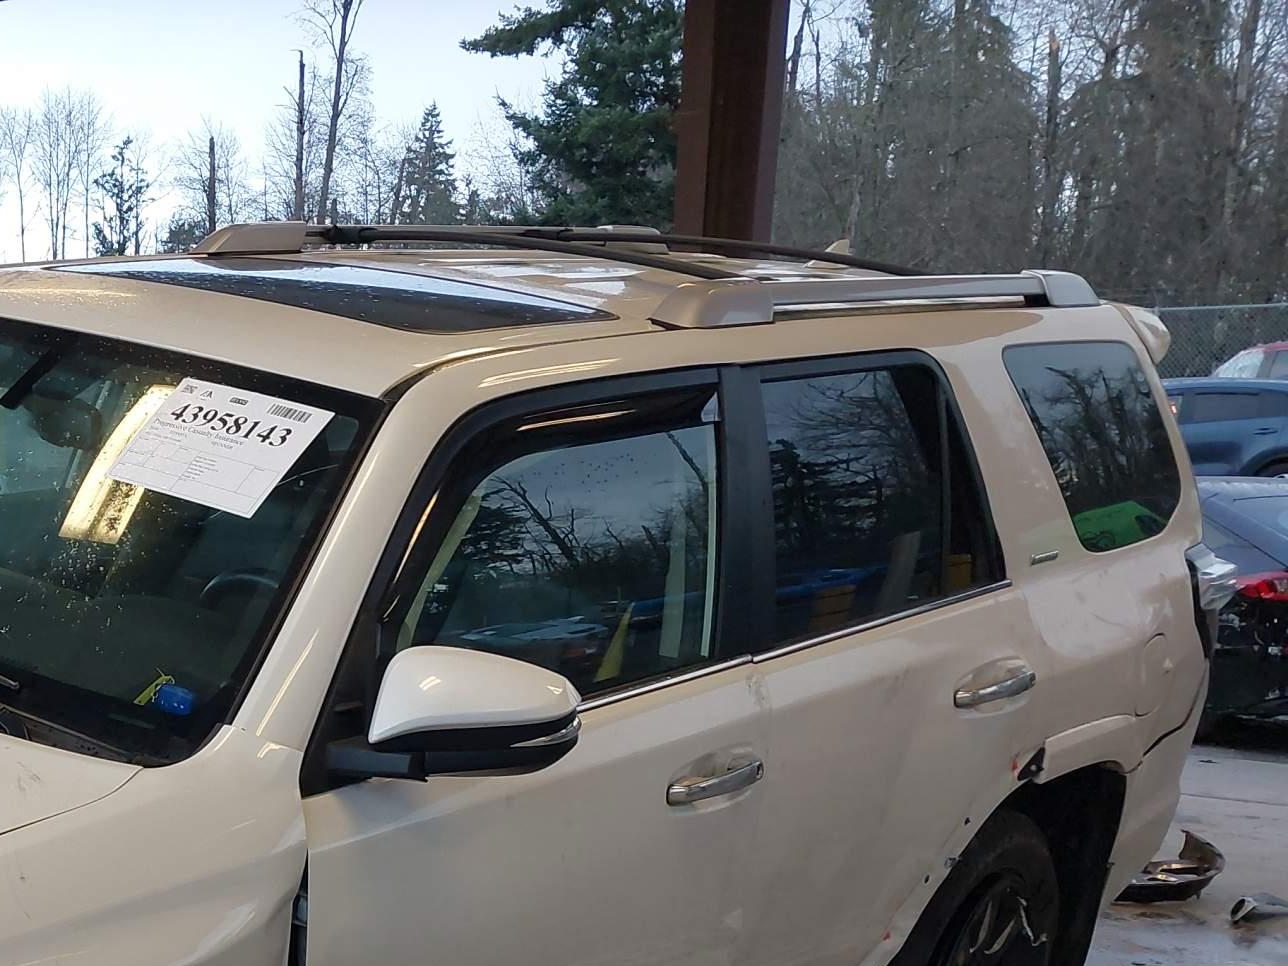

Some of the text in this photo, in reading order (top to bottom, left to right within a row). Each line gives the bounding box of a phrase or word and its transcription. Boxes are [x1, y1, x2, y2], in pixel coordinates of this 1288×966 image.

[153, 417, 188, 432] Progressive
[187, 425, 213, 440] Casualty
[214, 431, 245, 446] Insurance
[170, 403, 293, 447] 43958143
